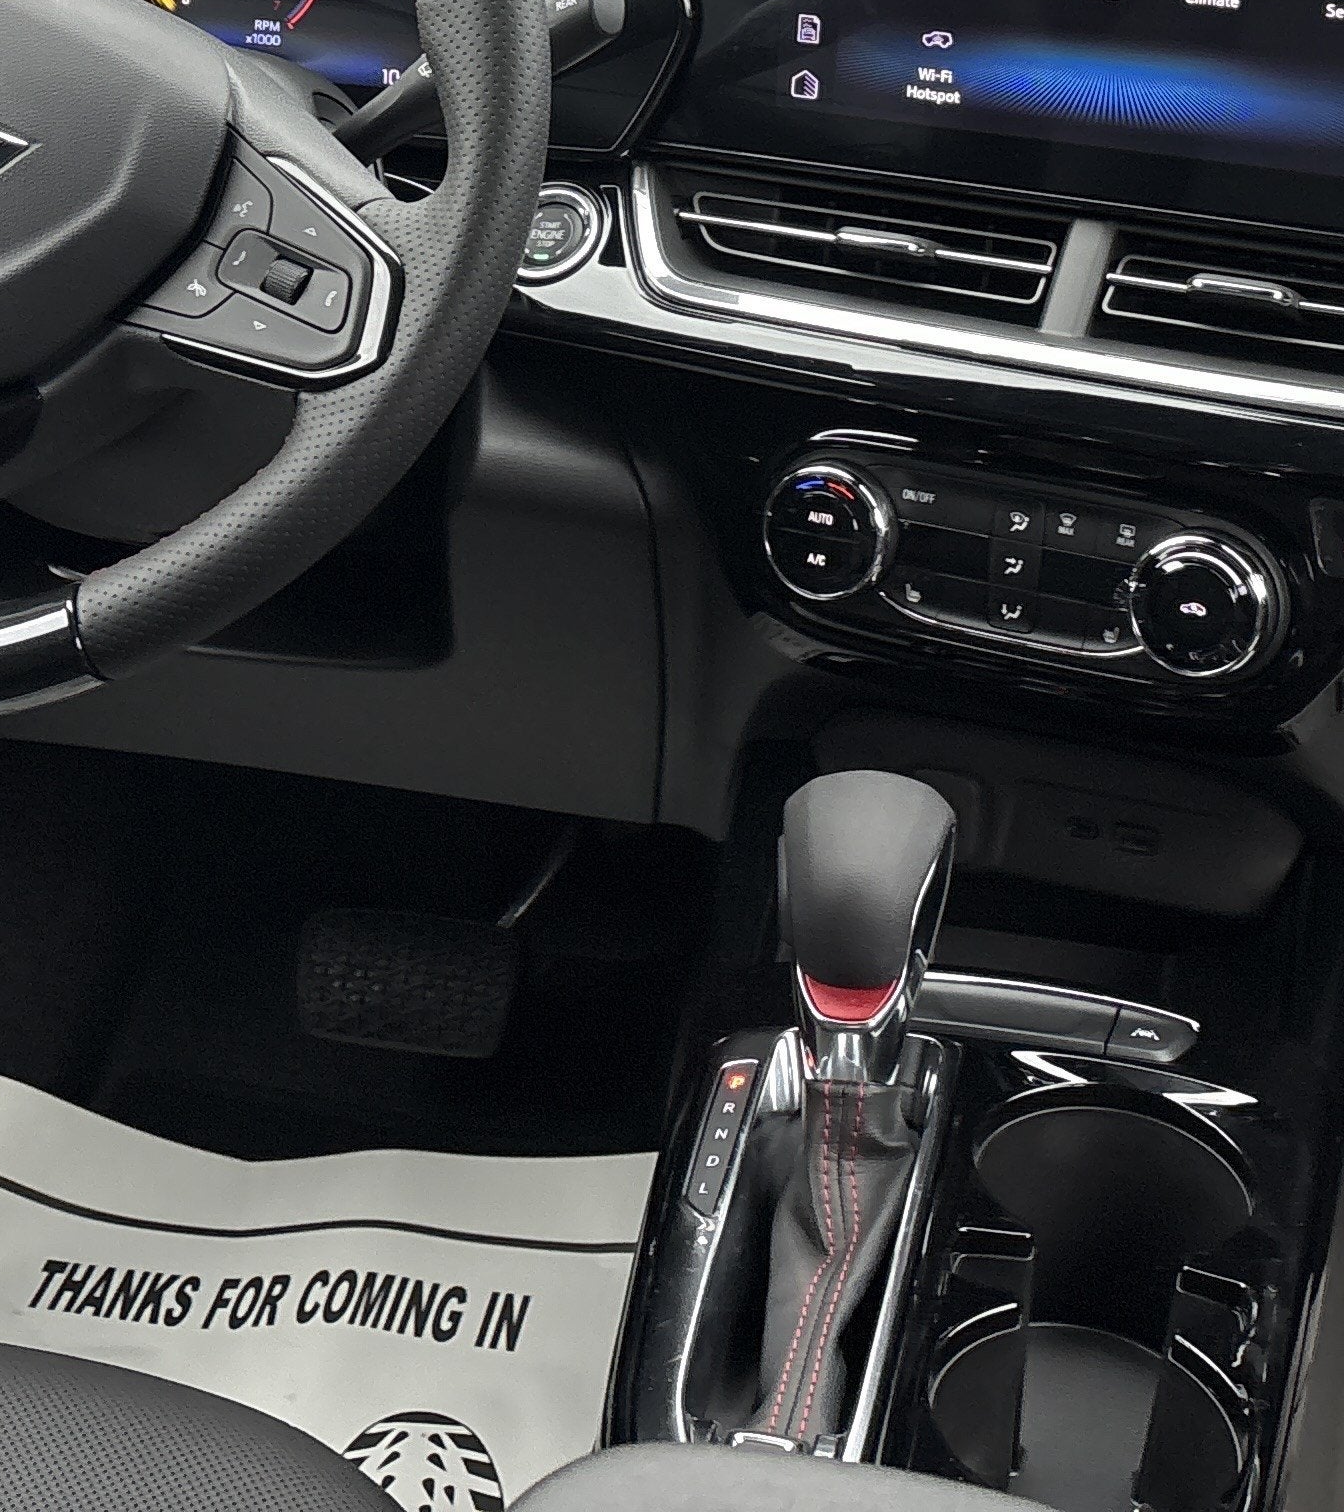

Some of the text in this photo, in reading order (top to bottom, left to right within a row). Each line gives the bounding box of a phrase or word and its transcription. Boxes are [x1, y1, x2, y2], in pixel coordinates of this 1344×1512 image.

[272, 0, 282, 11] 7
[254, 19, 281, 32] RPM
[245, 33, 282, 46] x1000
[917, 66, 953, 84] Wi-Fi
[906, 84, 961, 105] Hotspot
[530, 229, 566, 240] ENGINE
[902, 489, 937, 504] ON/OFF
[808, 510, 834, 526] AUTO
[806, 552, 827, 567] A/C
[729, 1075, 745, 1089] P
[722, 1102, 736, 1114] R
[715, 1128, 729, 1139] N
[706, 1155, 720, 1167] D
[699, 1183, 709, 1194] L
[29, 1259, 531, 1352] THANKS FOR COMING IN
